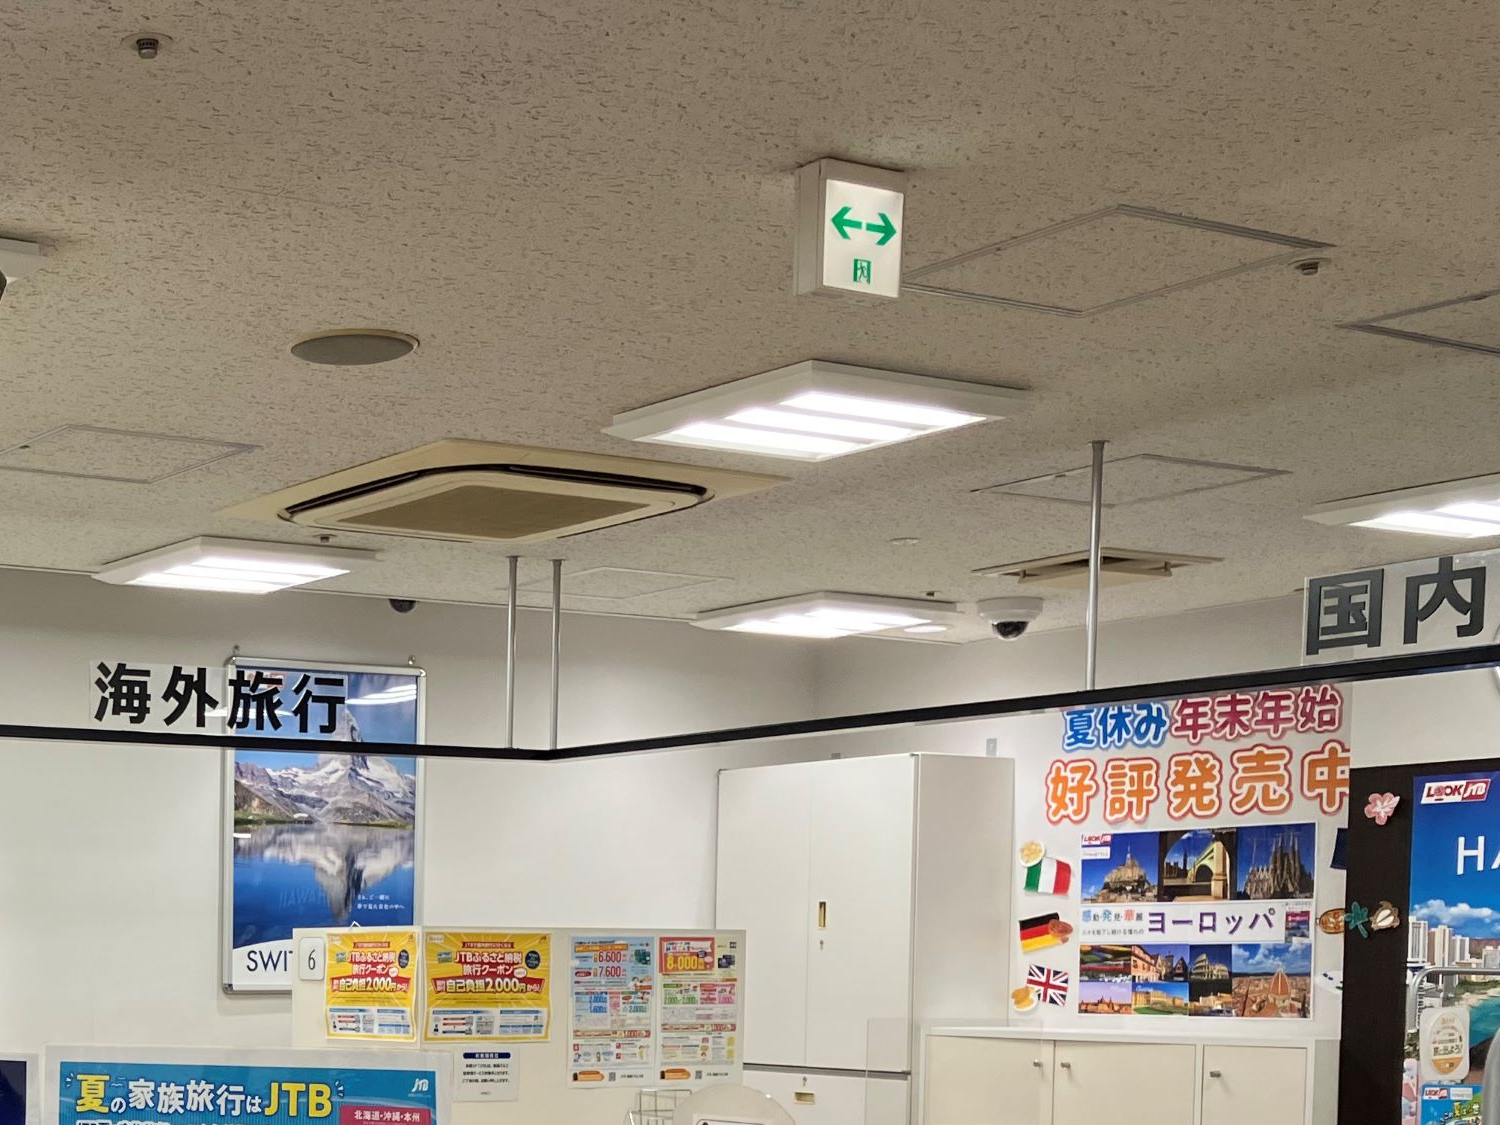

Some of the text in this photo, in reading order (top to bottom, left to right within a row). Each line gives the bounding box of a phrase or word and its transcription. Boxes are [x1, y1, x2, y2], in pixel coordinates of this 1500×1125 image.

[1305, 556, 1487, 656] 国内
[94, 662, 346, 734] 海外旅行
[1066, 686, 1342, 747] 夏休み 年末年始
[1047, 745, 1350, 821] 好評発売中
[1148, 908, 1276, 934] ヨーロッパ
[307, 948, 316, 971] 6
[74, 1073, 333, 1119] 夏の家族旅行はJTB
